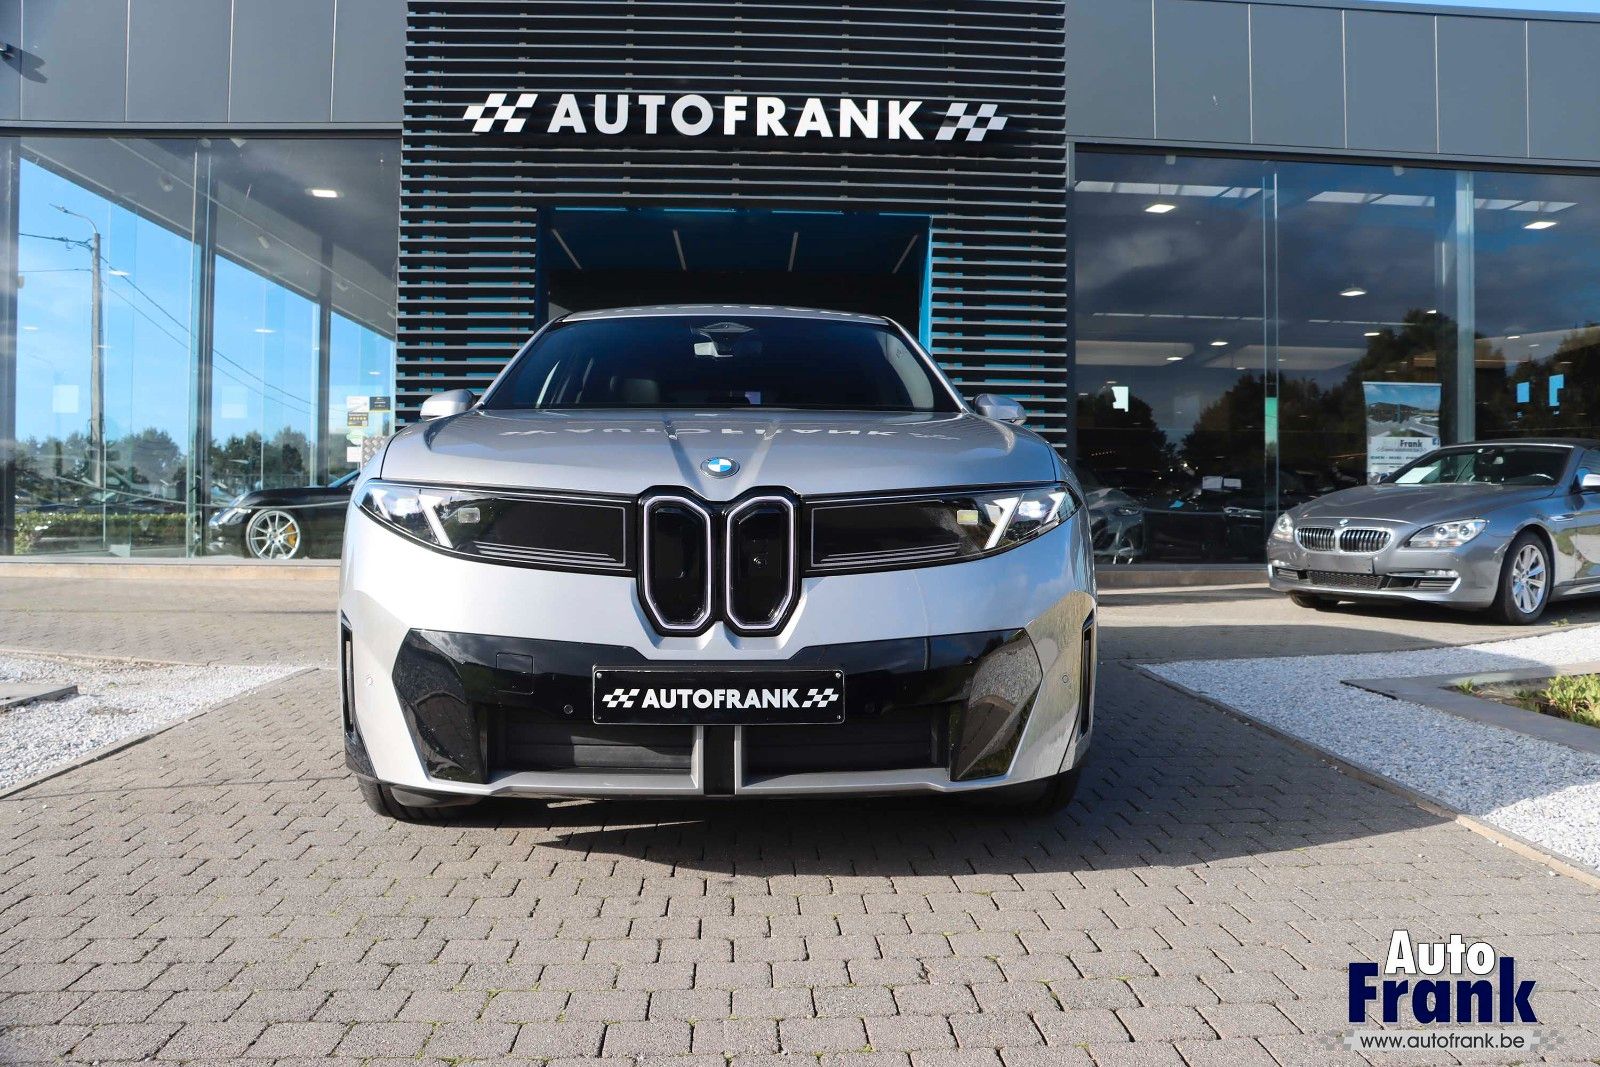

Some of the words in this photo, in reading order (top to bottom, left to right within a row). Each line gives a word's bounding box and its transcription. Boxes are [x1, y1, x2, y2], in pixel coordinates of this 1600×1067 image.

[547, 93, 924, 141] AUTOFRANK
[1400, 440, 1423, 448] Frank
[641, 688, 800, 709] AUTOFRANK
